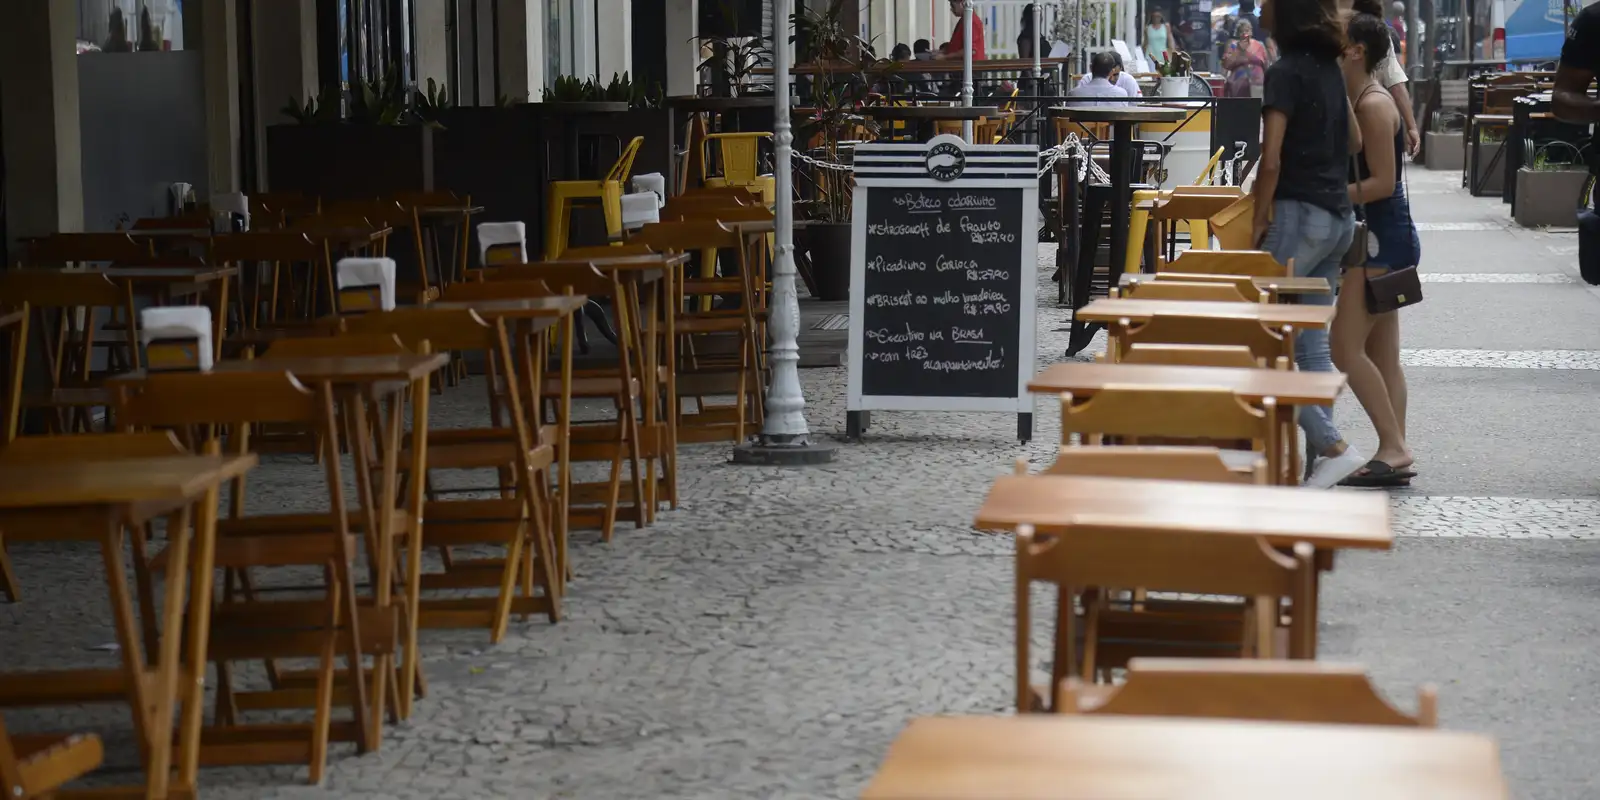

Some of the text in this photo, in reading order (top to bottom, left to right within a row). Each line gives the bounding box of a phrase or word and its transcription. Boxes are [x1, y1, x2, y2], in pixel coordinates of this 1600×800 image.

[934, 145, 959, 155] GOOSE
[933, 168, 959, 179] ISLAND
[936, 217, 951, 233] de
